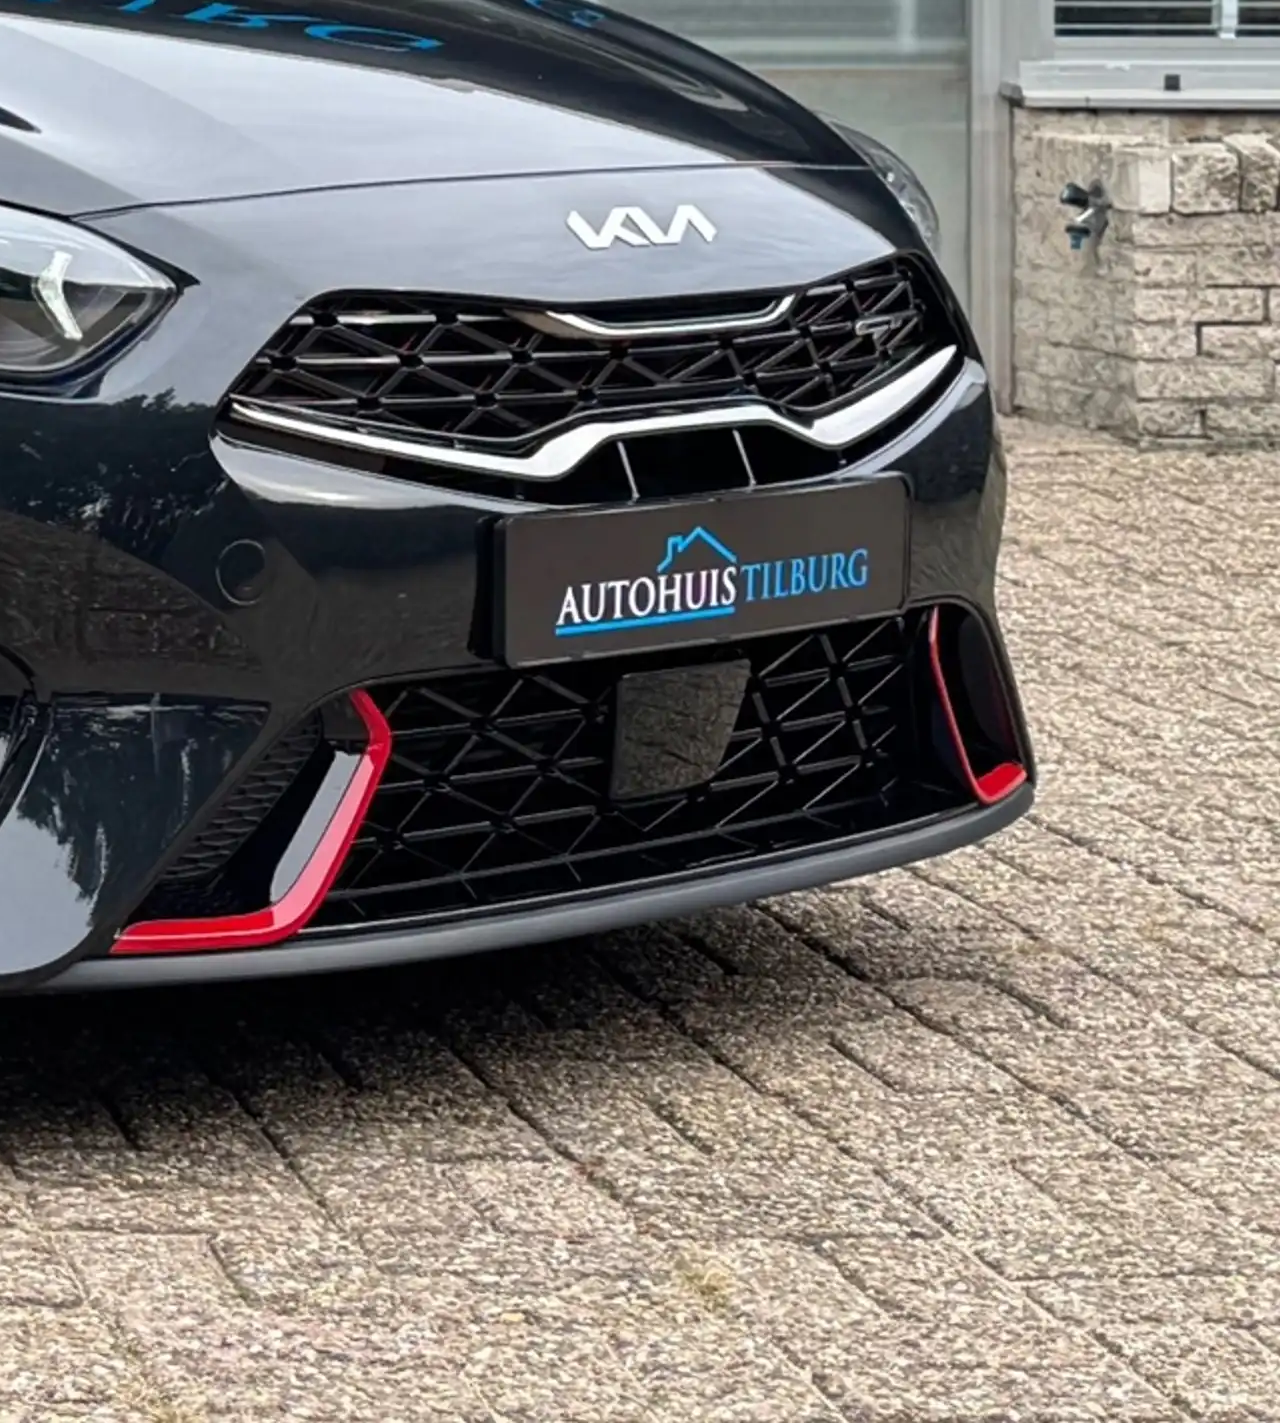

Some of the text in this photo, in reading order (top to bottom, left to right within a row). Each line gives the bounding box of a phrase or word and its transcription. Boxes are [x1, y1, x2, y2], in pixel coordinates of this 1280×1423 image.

[566, 205, 717, 250] KIA
[556, 549, 868, 625] AUTOHUIS TILBURG
